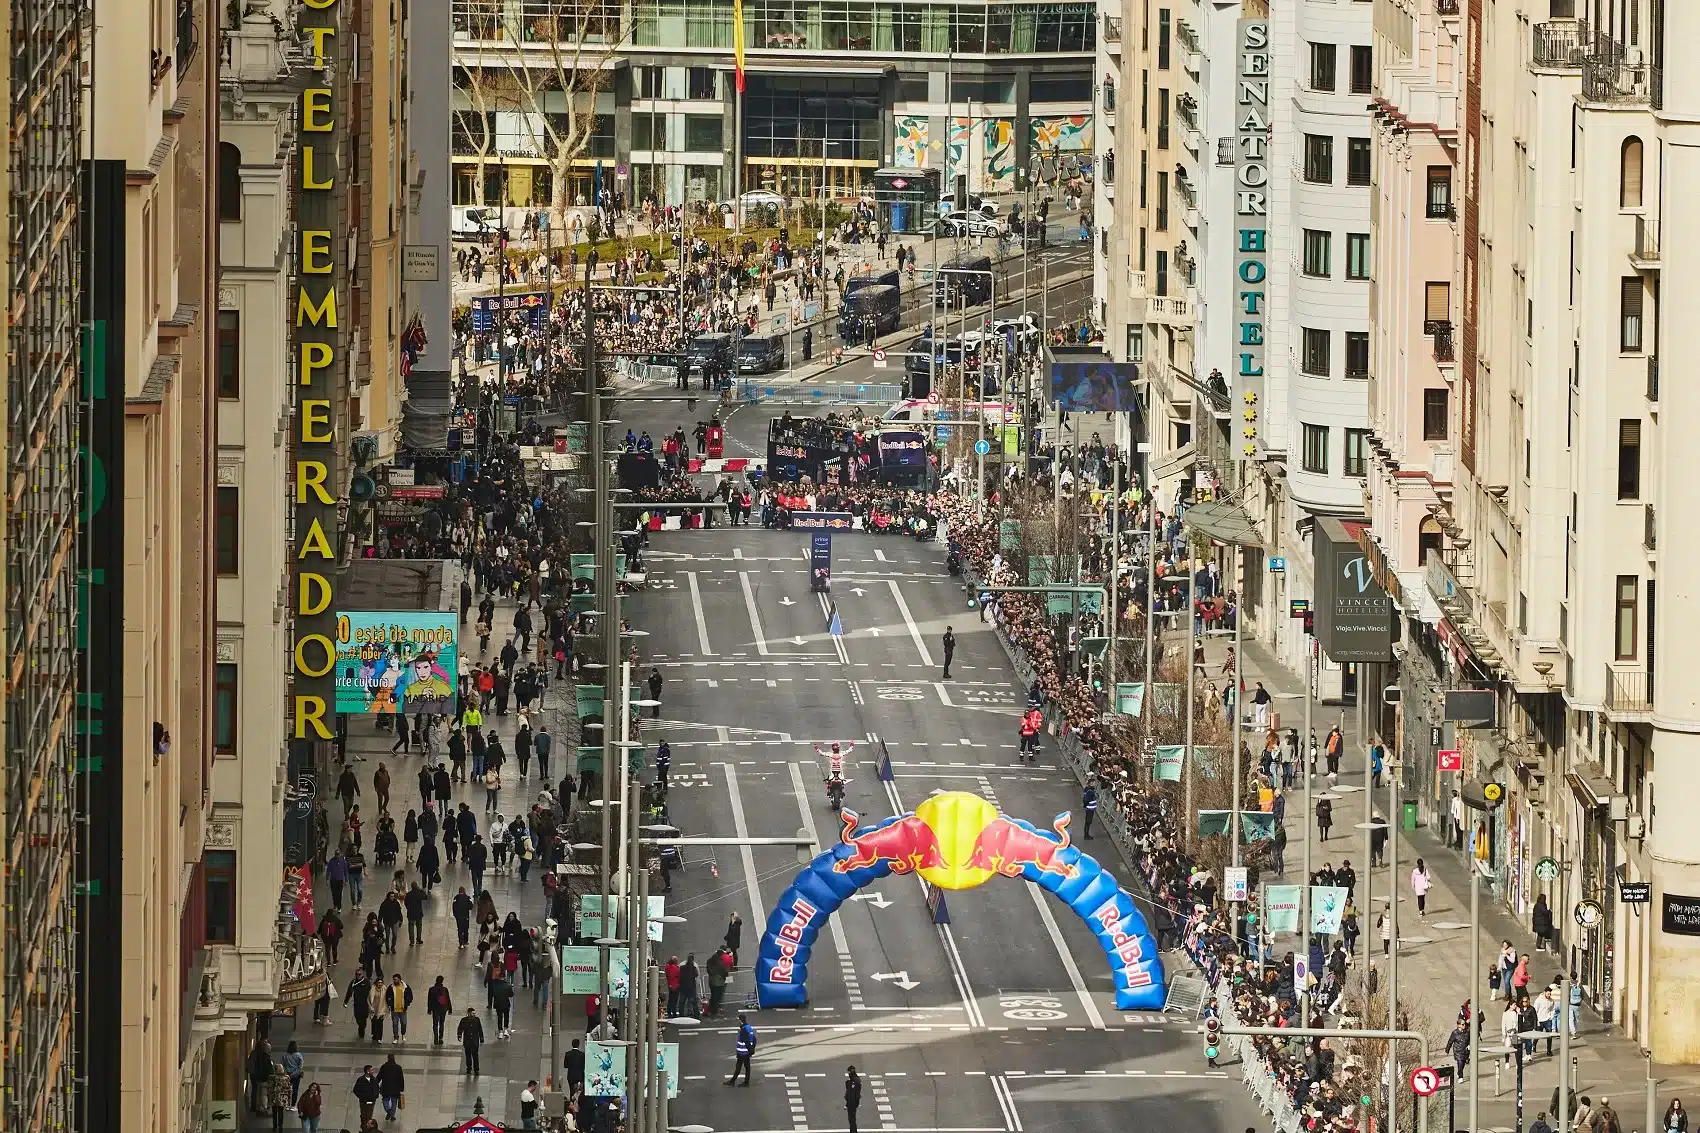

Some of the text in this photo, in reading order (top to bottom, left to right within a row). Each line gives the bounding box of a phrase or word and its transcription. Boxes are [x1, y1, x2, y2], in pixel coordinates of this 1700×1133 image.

[302, 0, 335, 190] TEL
[1238, 24, 1269, 376] SENATOR HOTEL
[295, 230, 338, 740] EMPERADOR
[336, 615, 452, 644] 0 está de moda
[354, 676, 389, 688] cultura
[583, 912, 615, 920] CARNAL
[564, 965, 598, 973] CARNAVAL
[1124, 1014, 1190, 1024] BUS
